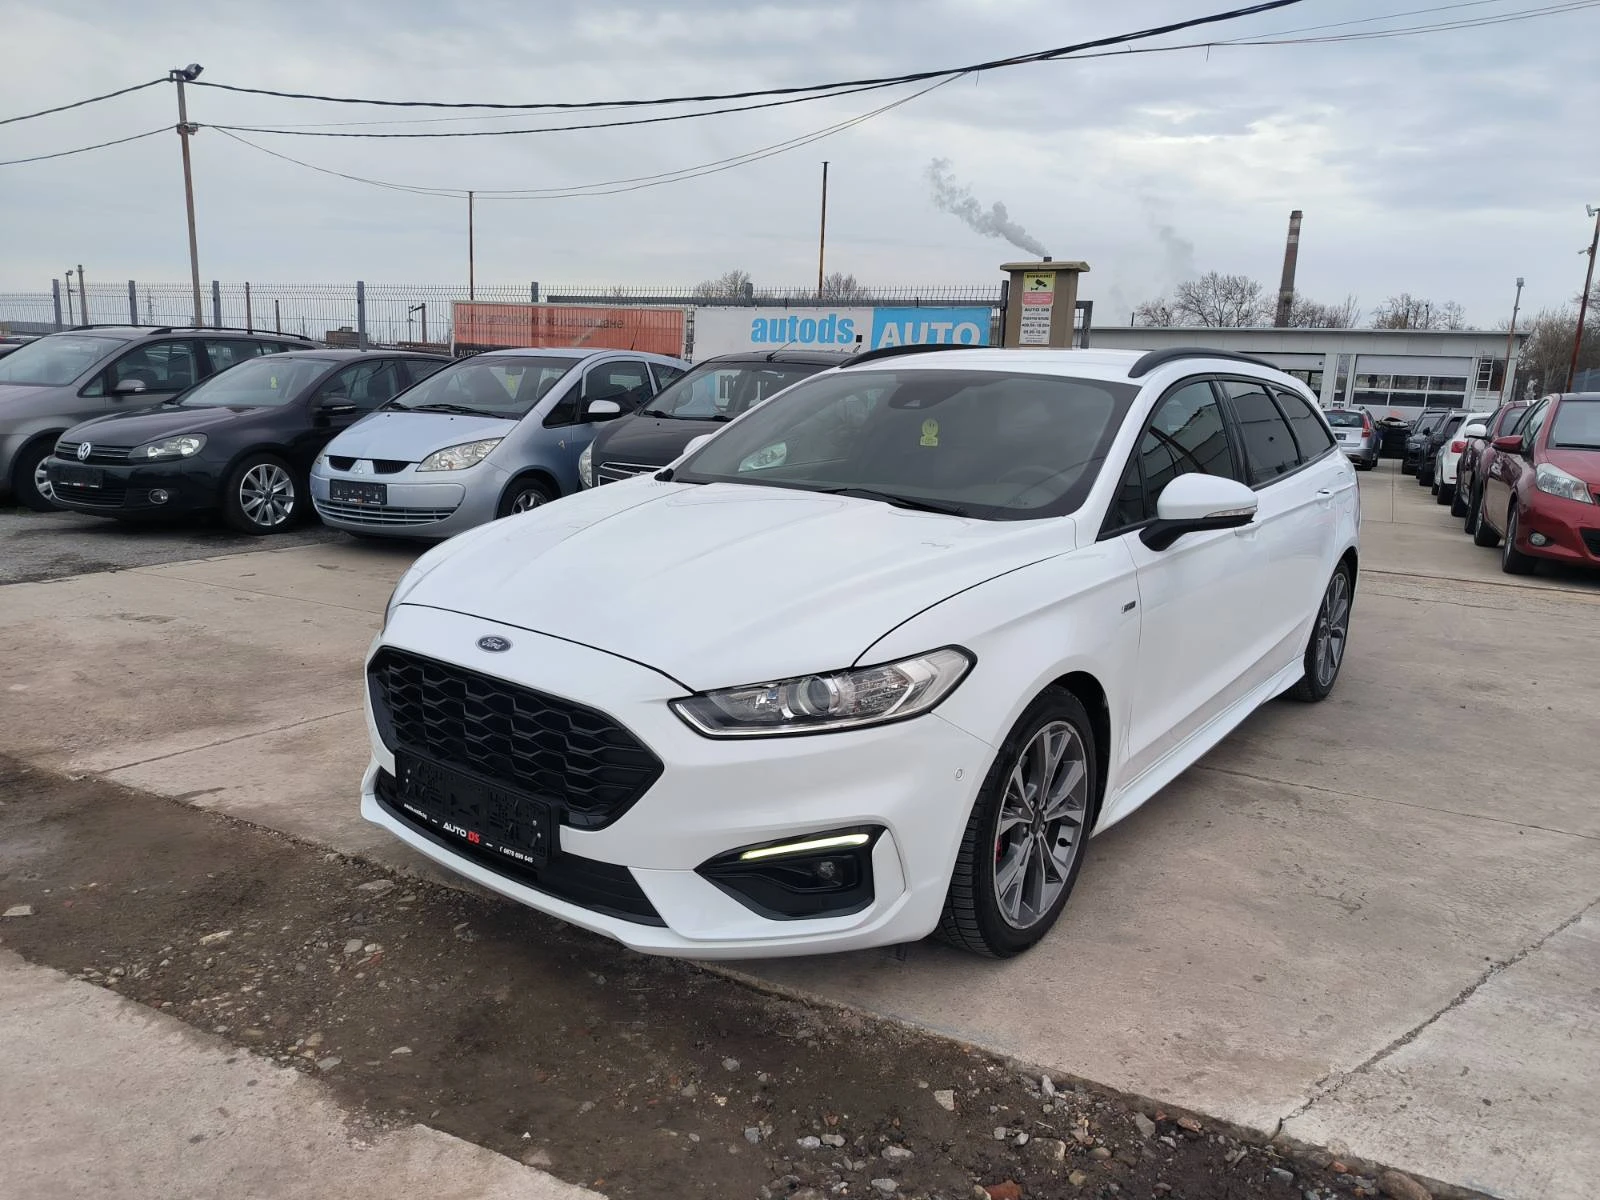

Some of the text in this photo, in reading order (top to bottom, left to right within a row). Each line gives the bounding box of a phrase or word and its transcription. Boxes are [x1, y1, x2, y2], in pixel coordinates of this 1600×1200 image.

[751, 314, 854, 344] autods
[877, 322, 981, 348] AUTO
[442, 821, 480, 844] AUTO DS
